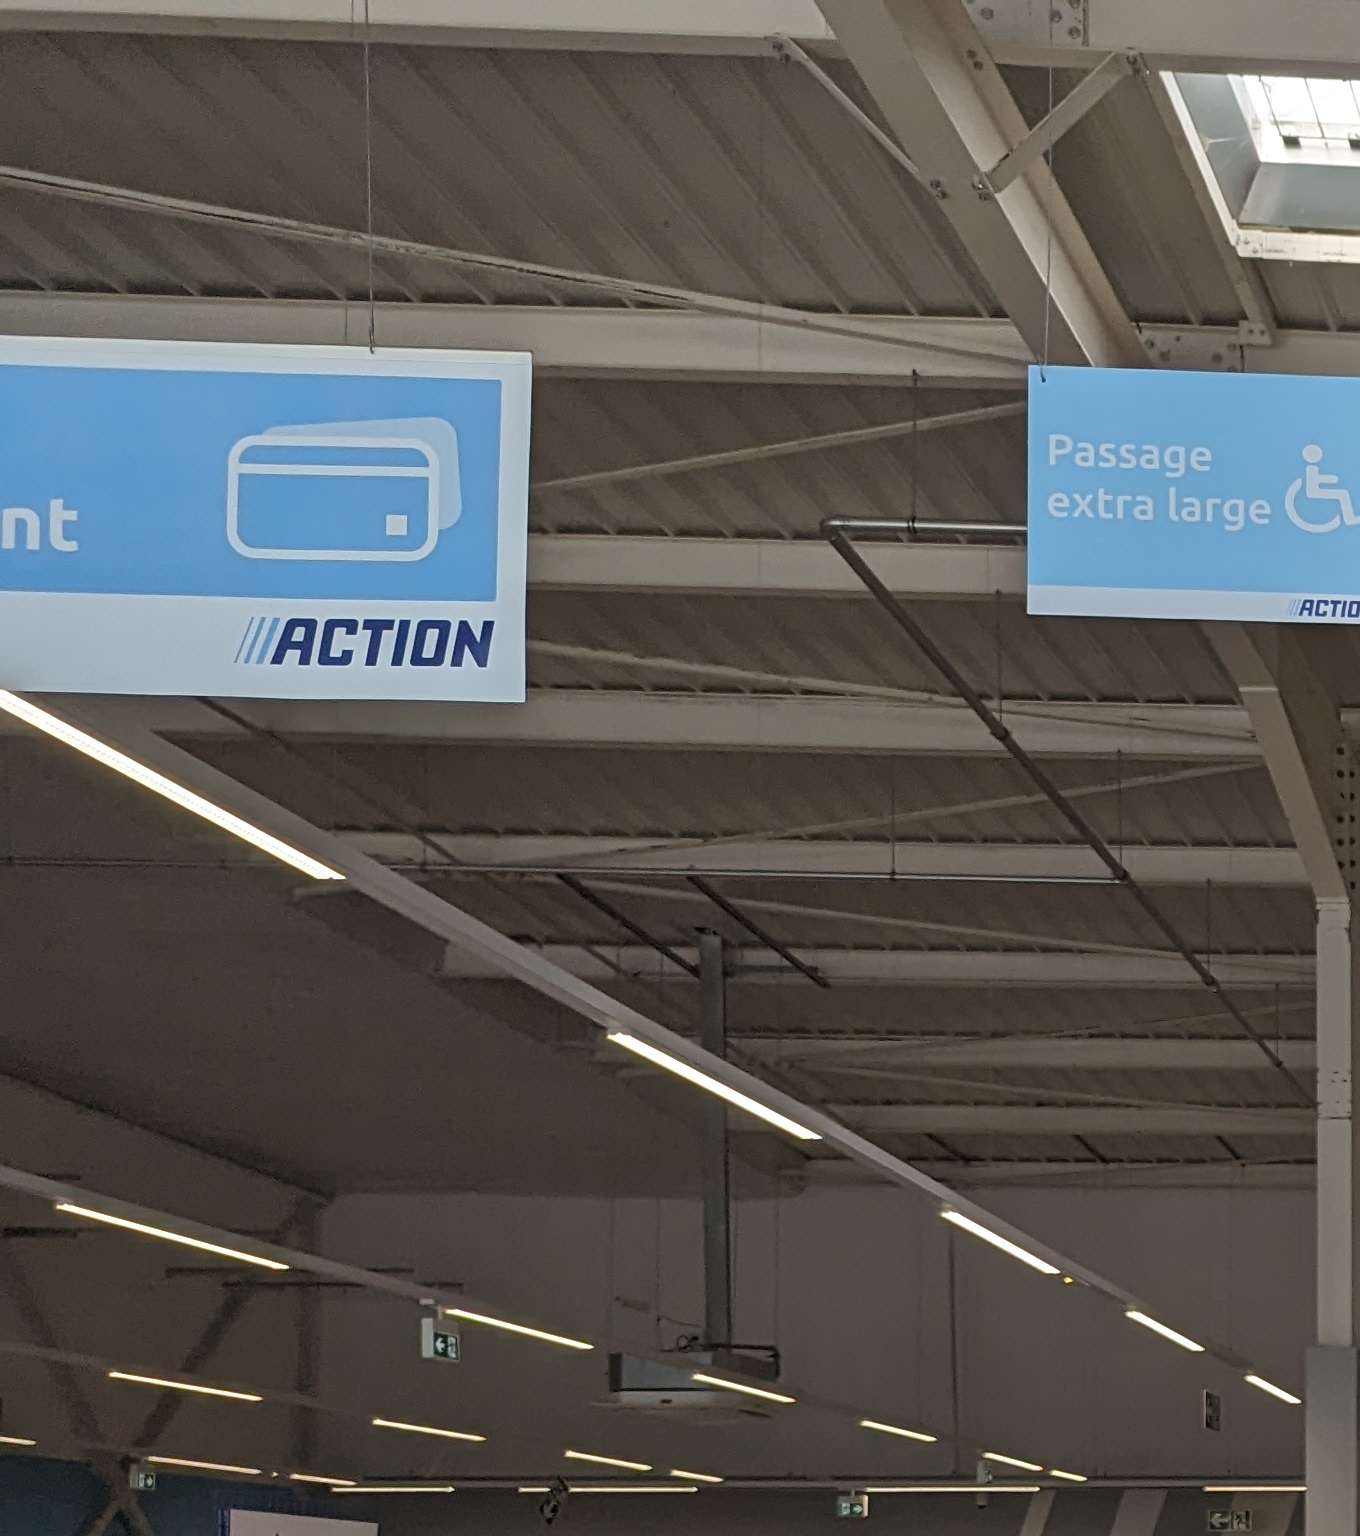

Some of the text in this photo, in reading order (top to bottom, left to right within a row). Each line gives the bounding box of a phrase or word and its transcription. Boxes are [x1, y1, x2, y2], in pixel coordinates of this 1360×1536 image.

[1048, 434, 1213, 478] Passage
[0, 499, 80, 553] nt
[1047, 486, 1272, 531] extra large
[270, 616, 496, 668] ACTION
